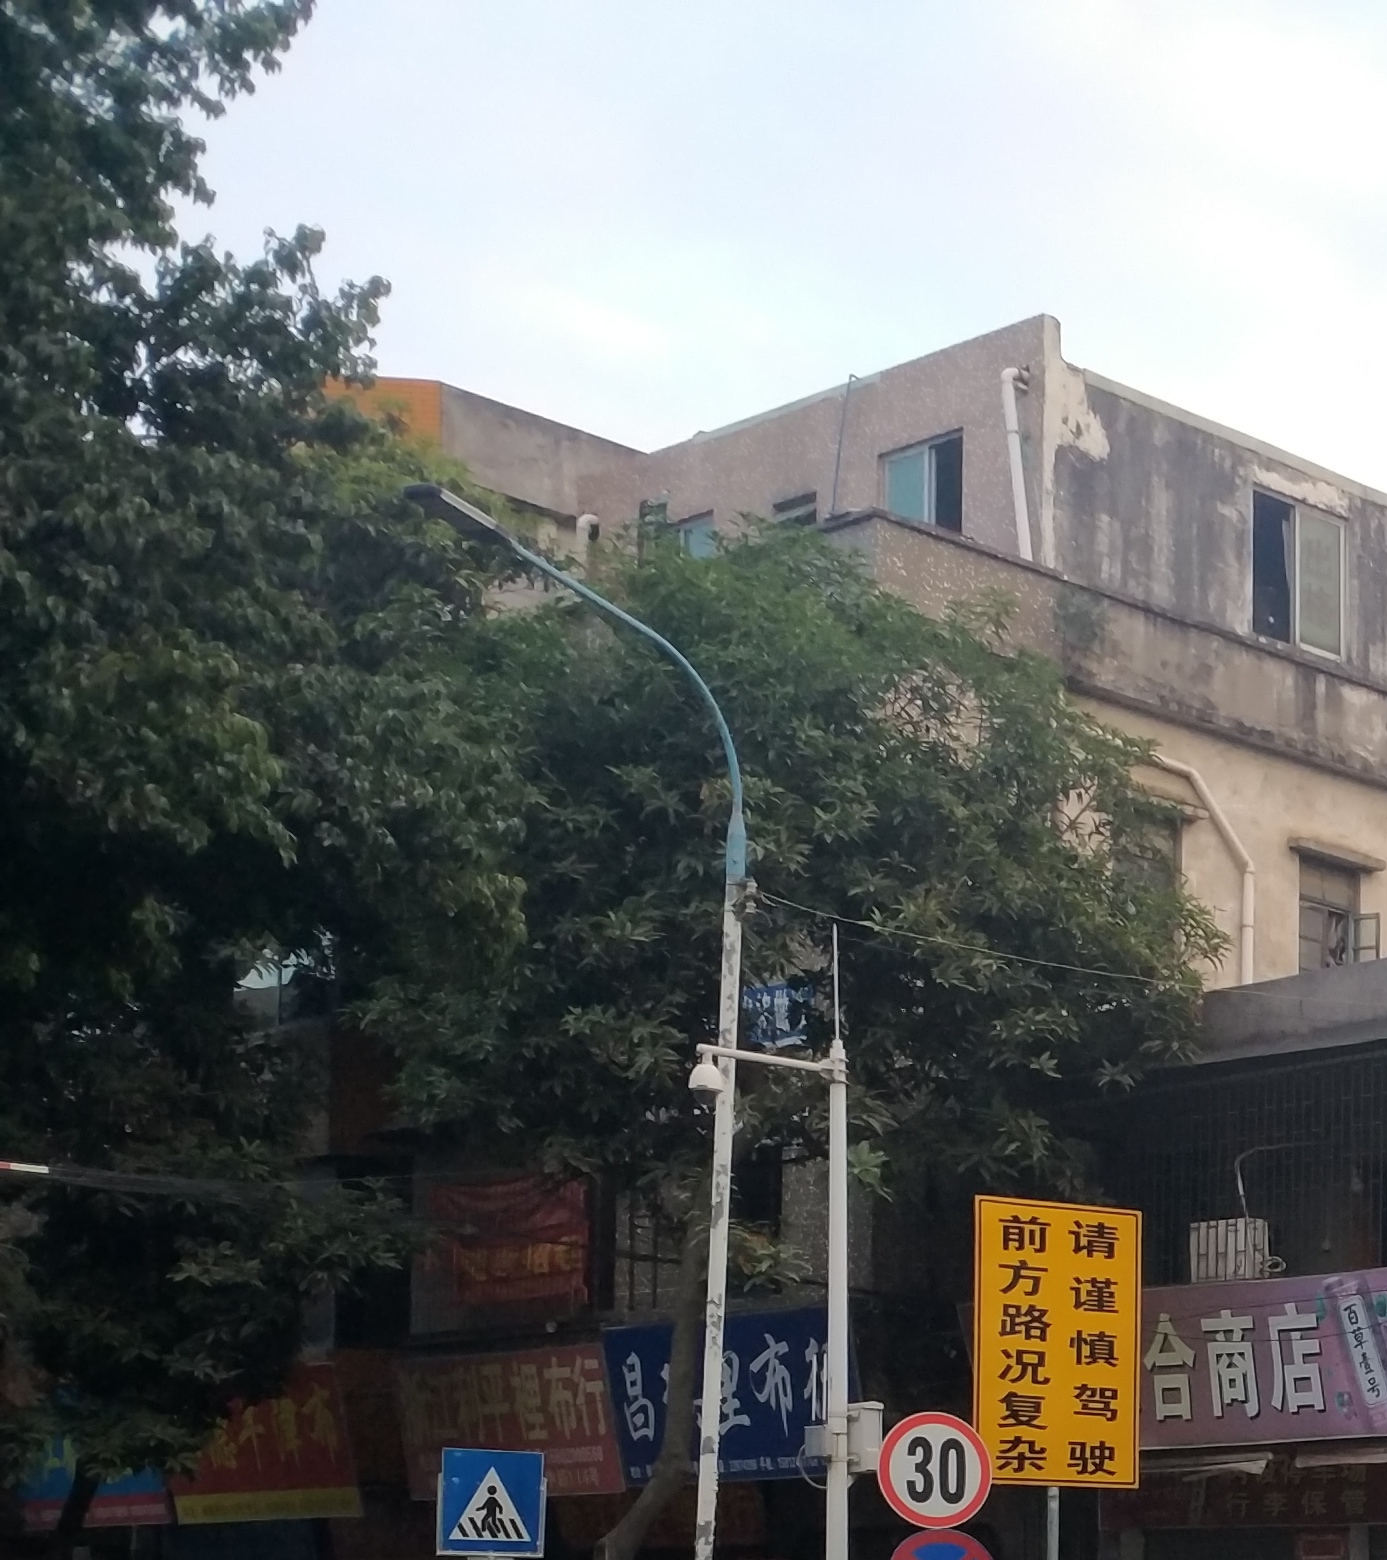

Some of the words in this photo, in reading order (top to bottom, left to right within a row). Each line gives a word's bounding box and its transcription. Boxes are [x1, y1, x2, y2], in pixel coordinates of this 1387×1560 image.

[994, 1214, 1052, 1474] 前方路况复杂
[1066, 1219, 1121, 1477] 请谨慎驾驶
[1143, 1303, 1326, 1422] 合商店
[1342, 1303, 1382, 1399] 百草壹号
[905, 1435, 967, 1505] 30
[1224, 1489, 1368, 1517] 行李保管
